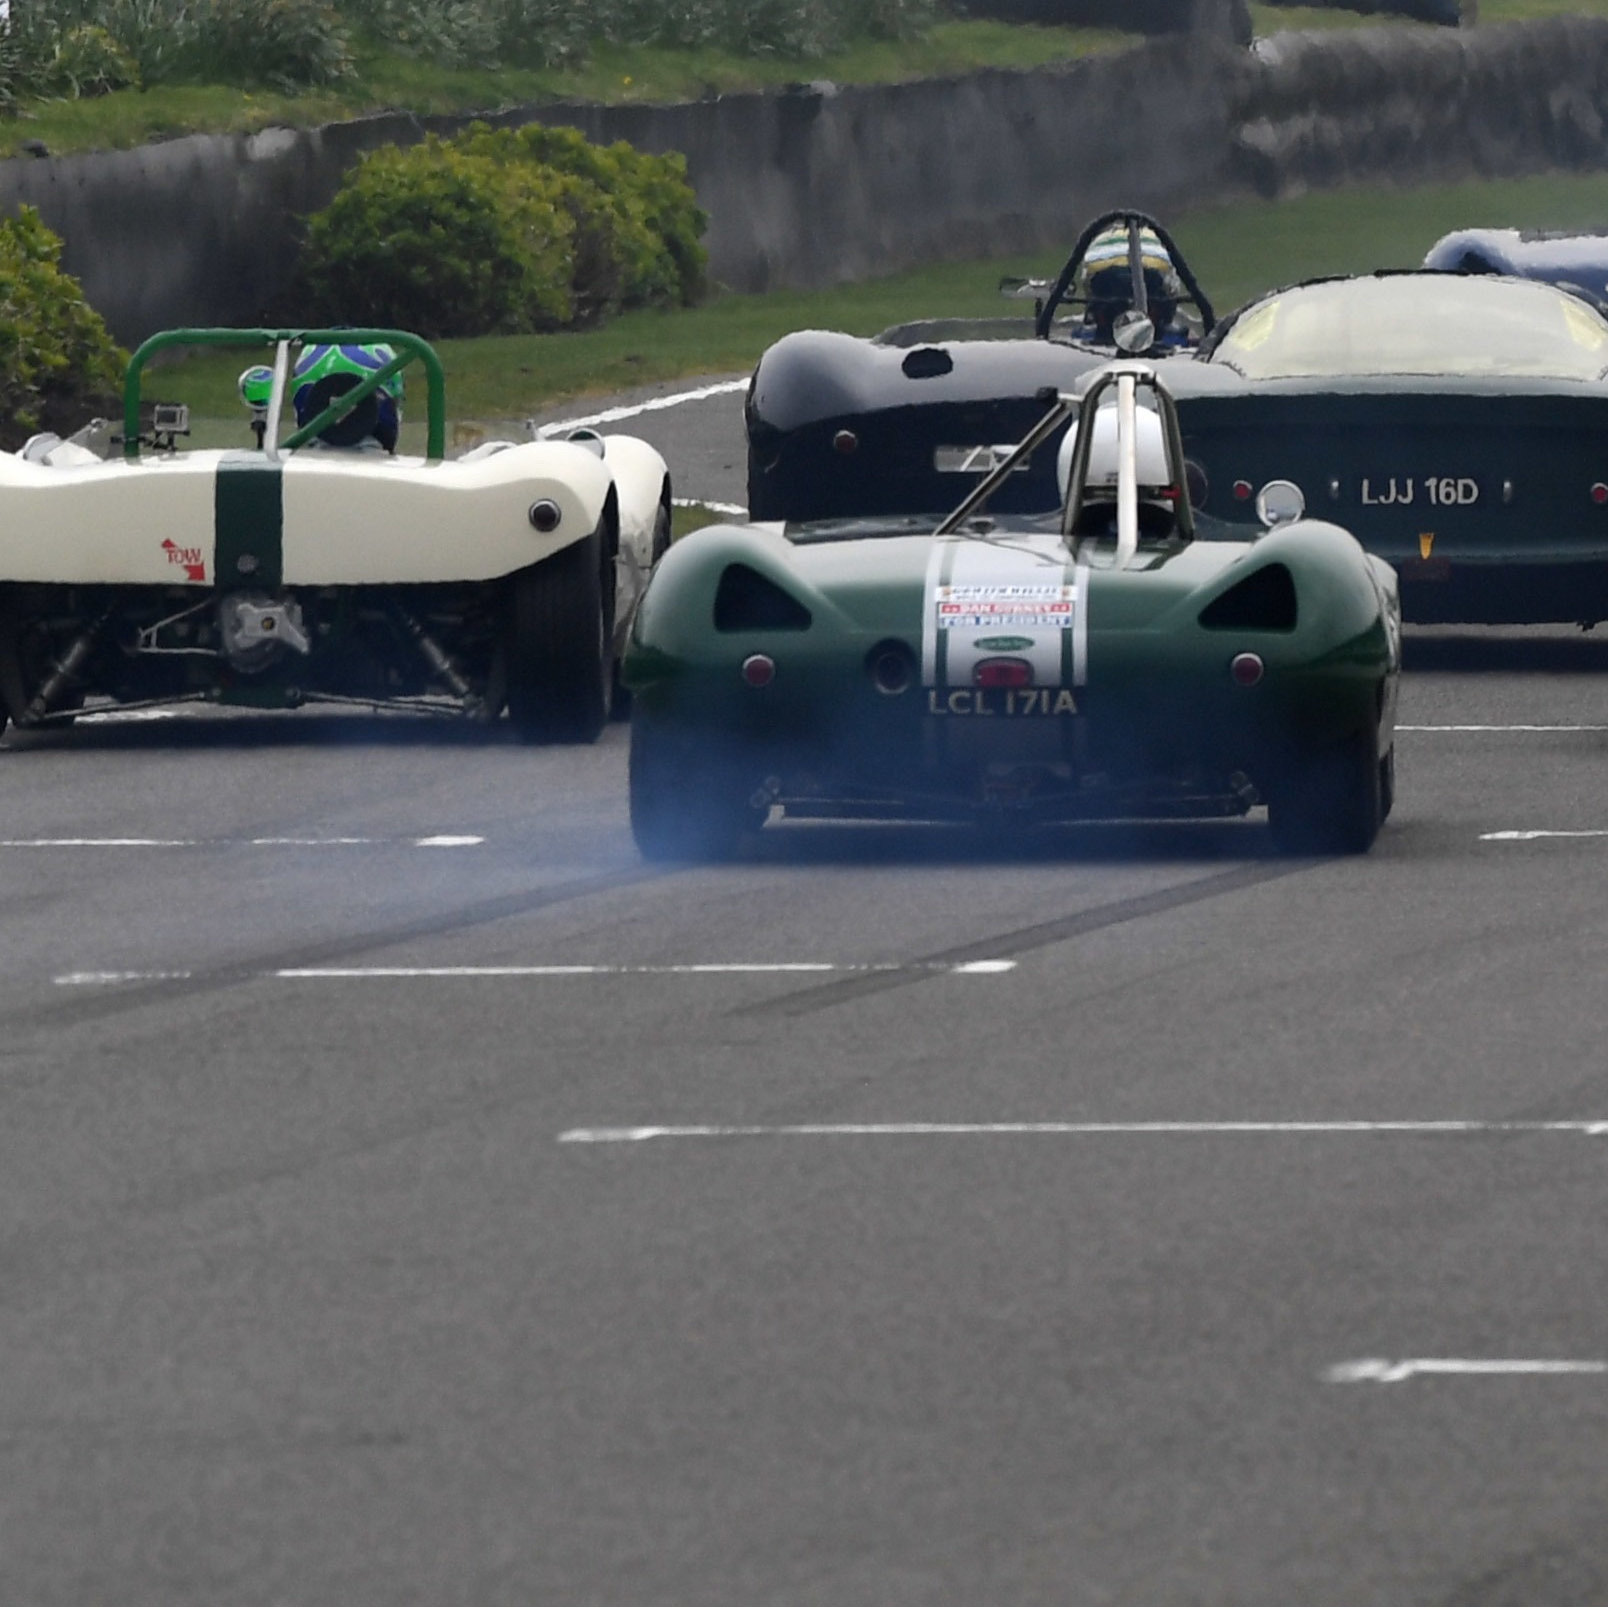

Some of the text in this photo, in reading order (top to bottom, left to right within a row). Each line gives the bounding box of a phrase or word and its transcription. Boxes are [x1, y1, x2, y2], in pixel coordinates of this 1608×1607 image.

[1361, 476, 1479, 505] LJJ 16D
[166, 547, 202, 564] TOW
[928, 688, 1078, 715] LCL 171A
